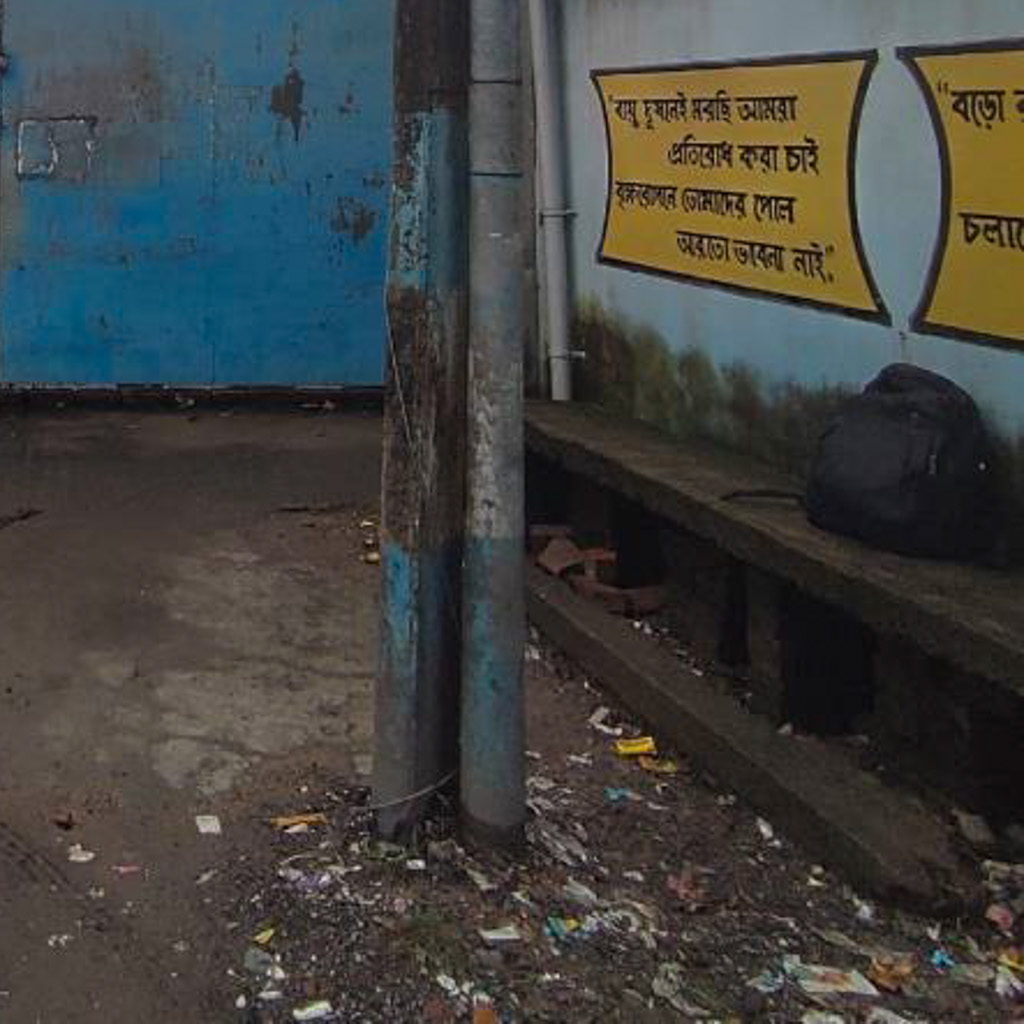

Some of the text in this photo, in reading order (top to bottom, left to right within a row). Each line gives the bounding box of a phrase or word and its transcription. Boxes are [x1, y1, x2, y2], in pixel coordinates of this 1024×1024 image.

[735, 95, 798, 123] আমরা
[738, 143, 779, 174] করা
[784, 135, 819, 176] চাই
